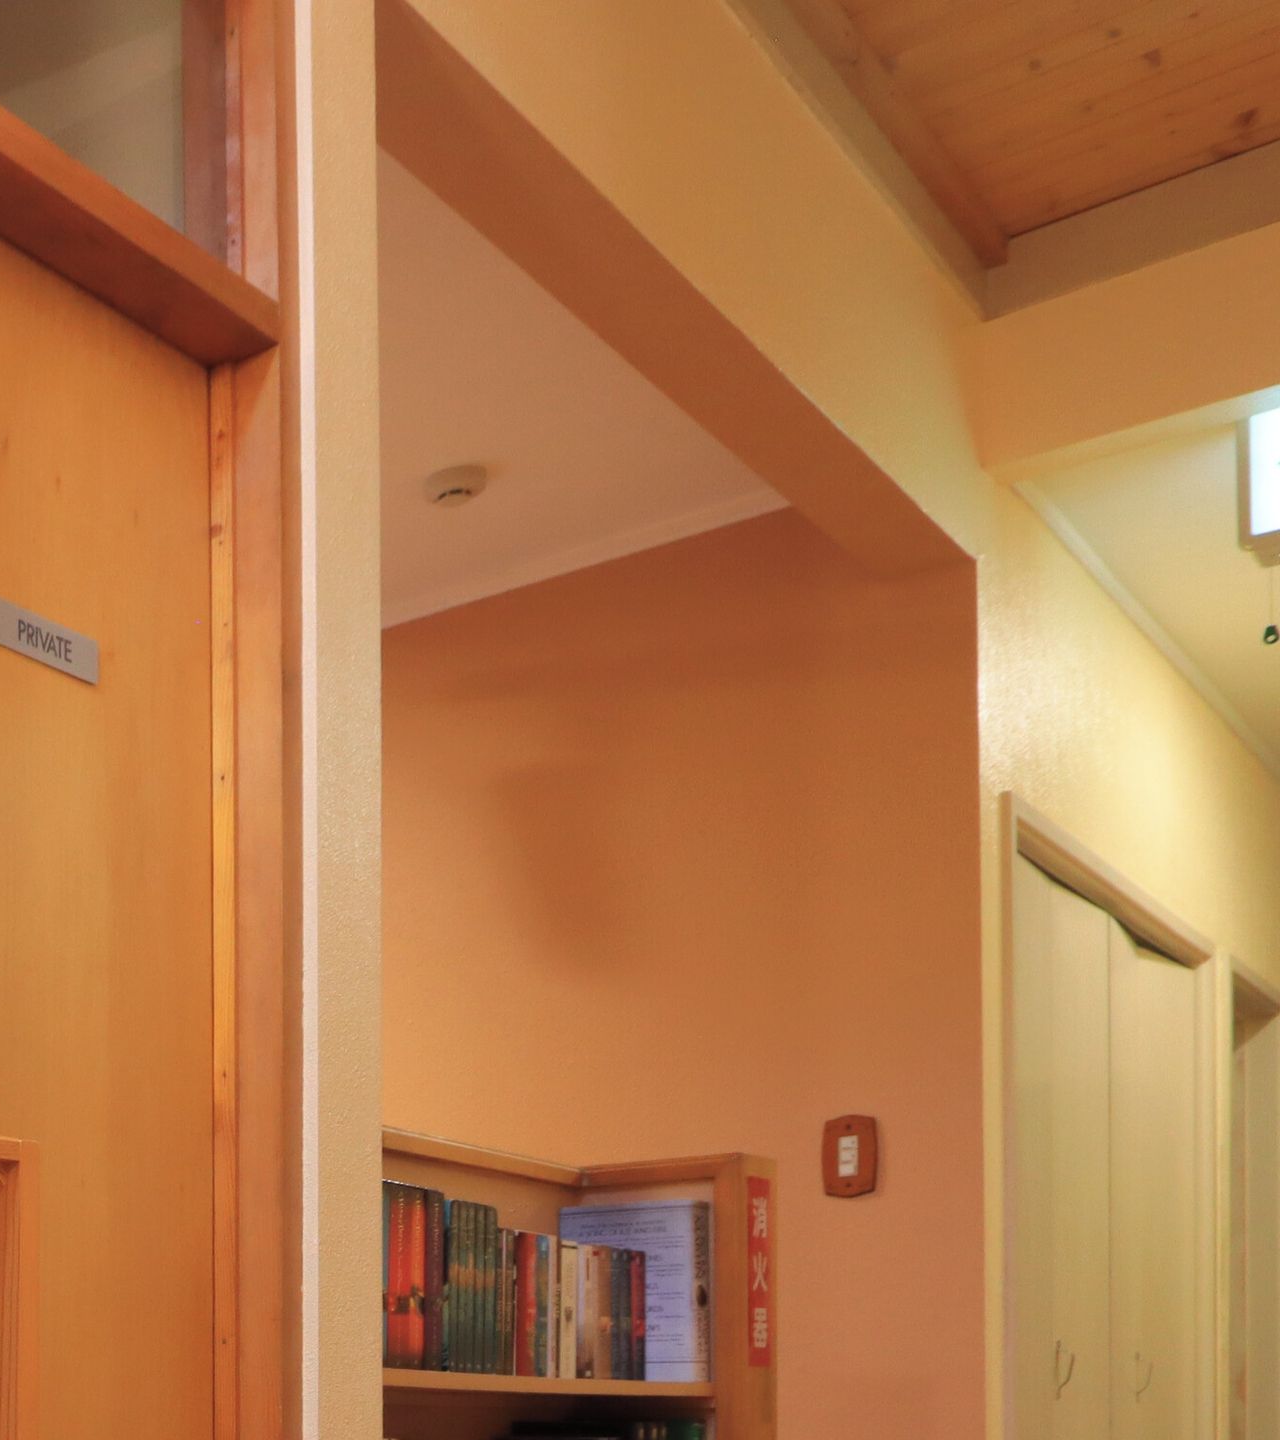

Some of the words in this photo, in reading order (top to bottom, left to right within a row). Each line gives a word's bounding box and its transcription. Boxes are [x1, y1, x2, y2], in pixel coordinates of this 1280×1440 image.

[17, 618, 73, 663] PRIVATE
[751, 1196, 769, 1349] 消火器
